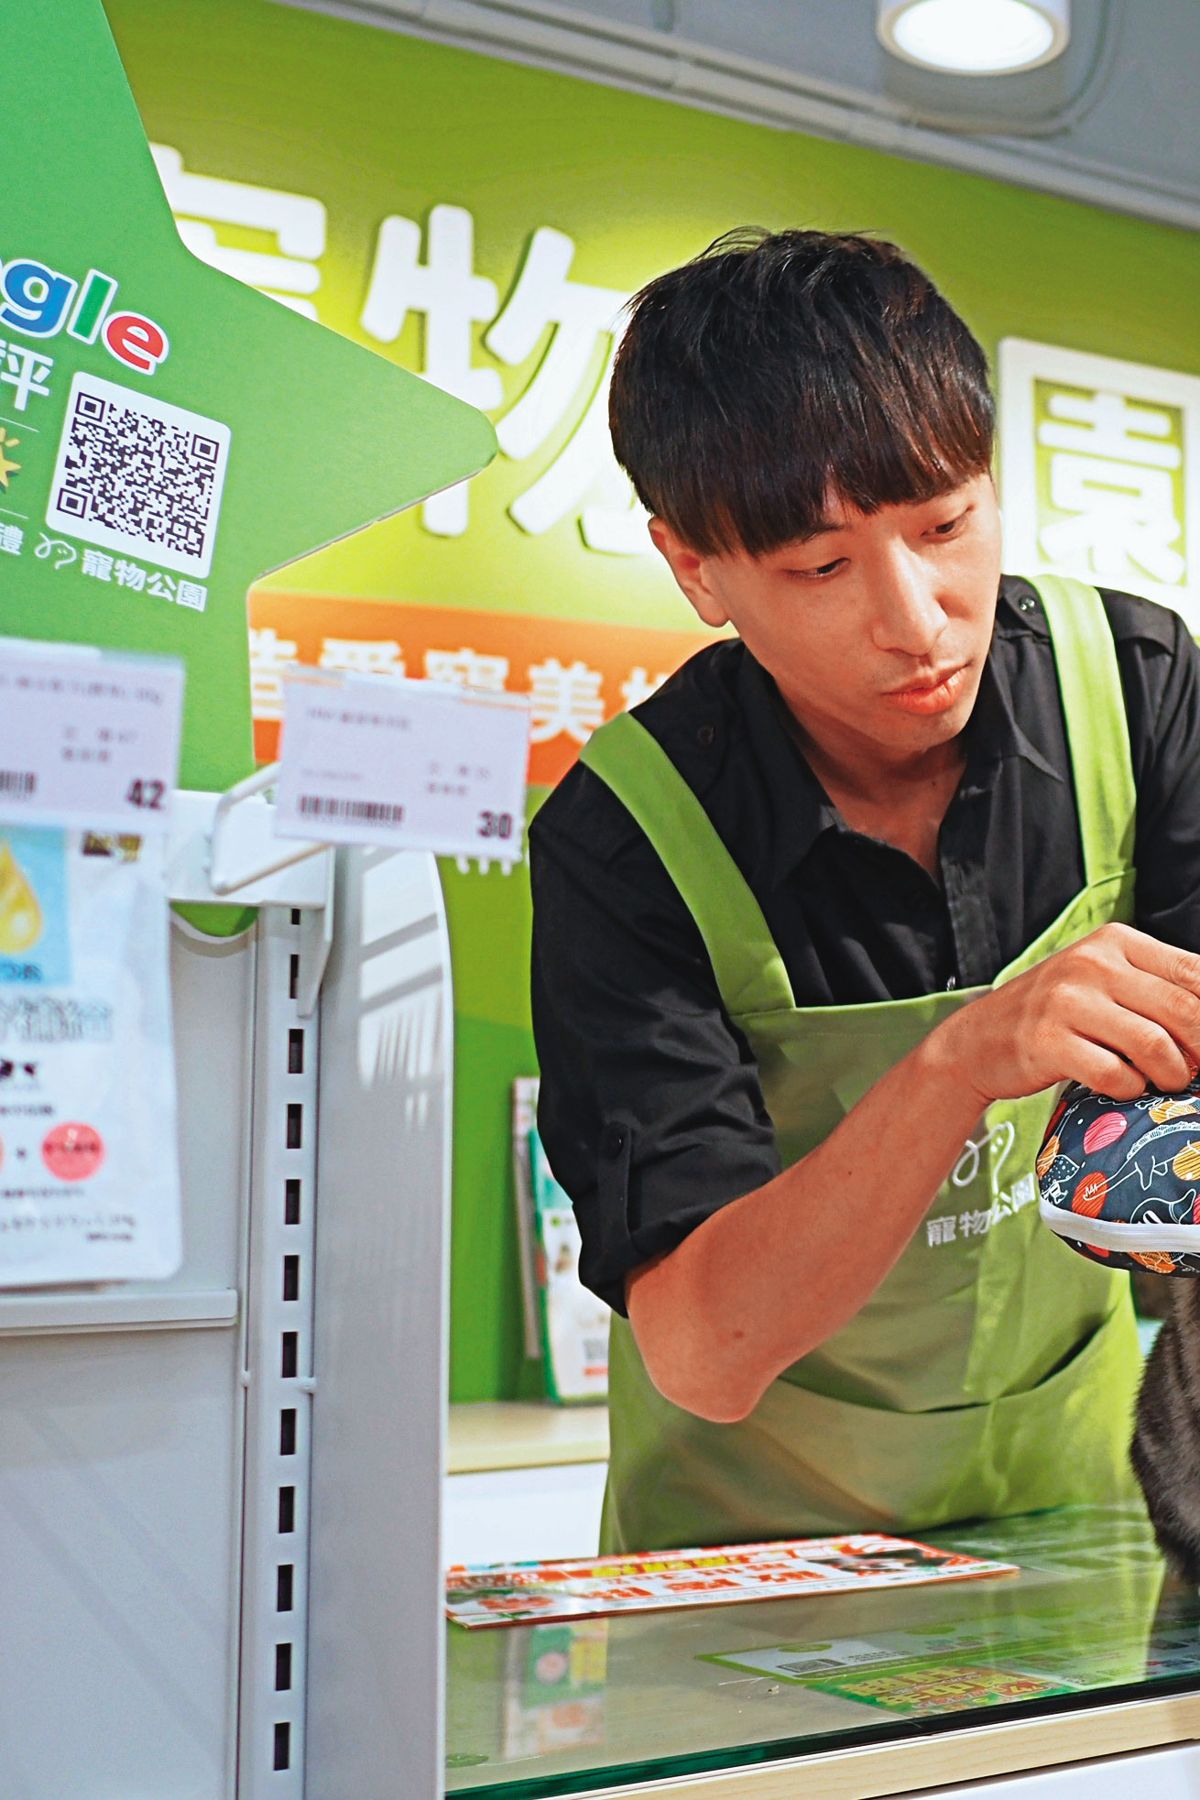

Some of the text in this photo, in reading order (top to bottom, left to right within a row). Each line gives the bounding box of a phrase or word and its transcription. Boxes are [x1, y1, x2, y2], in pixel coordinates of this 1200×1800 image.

[0, 258, 169, 376] gle
[81, 548, 208, 613] 寵物公園
[127, 778, 166, 810] 42
[478, 810, 514, 841] 30
